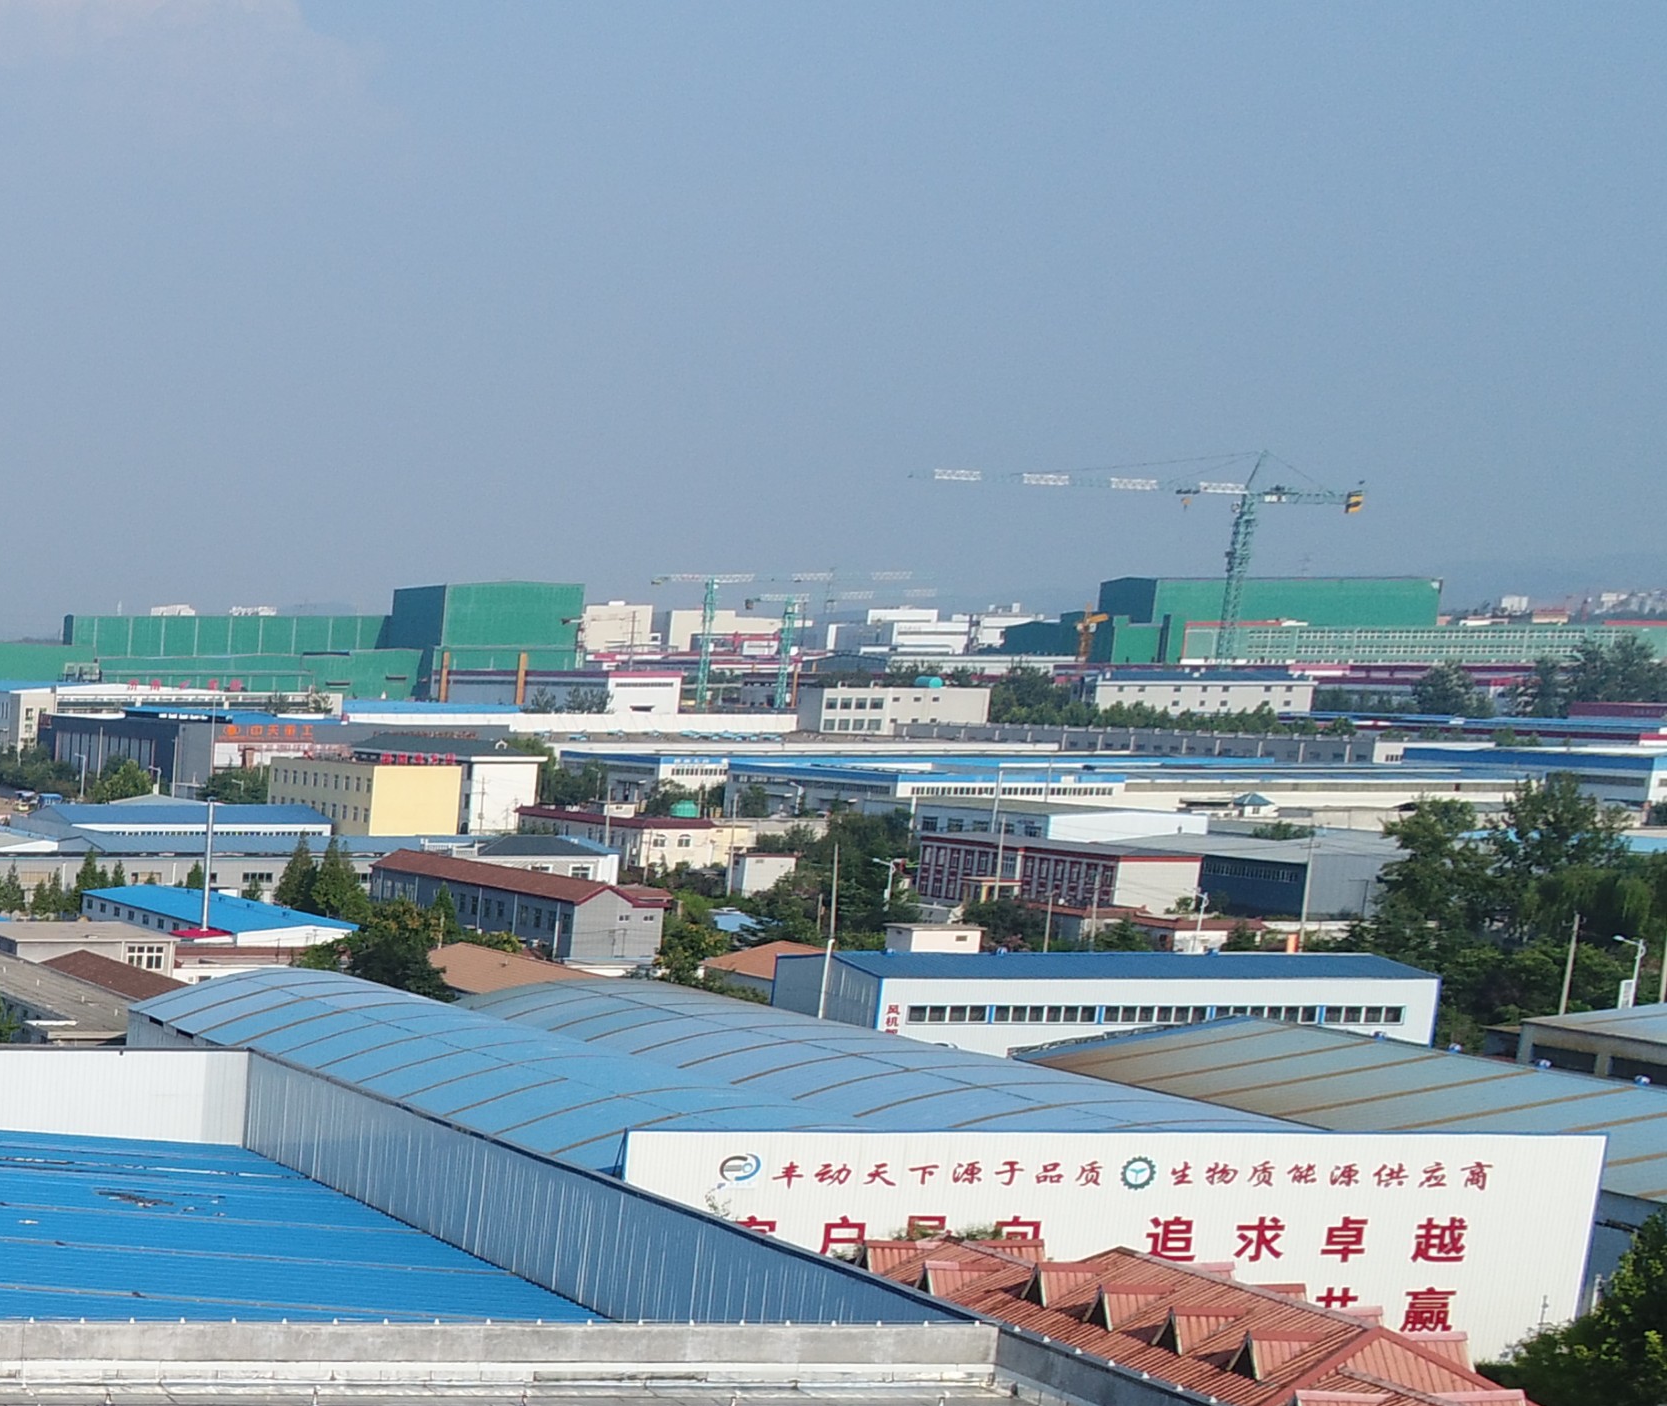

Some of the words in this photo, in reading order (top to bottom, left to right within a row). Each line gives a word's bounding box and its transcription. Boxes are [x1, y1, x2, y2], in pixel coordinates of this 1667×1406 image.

[1169, 1160, 1495, 1191] 生物质能源供应商
[1145, 1216, 1469, 1263] 追求卓越
